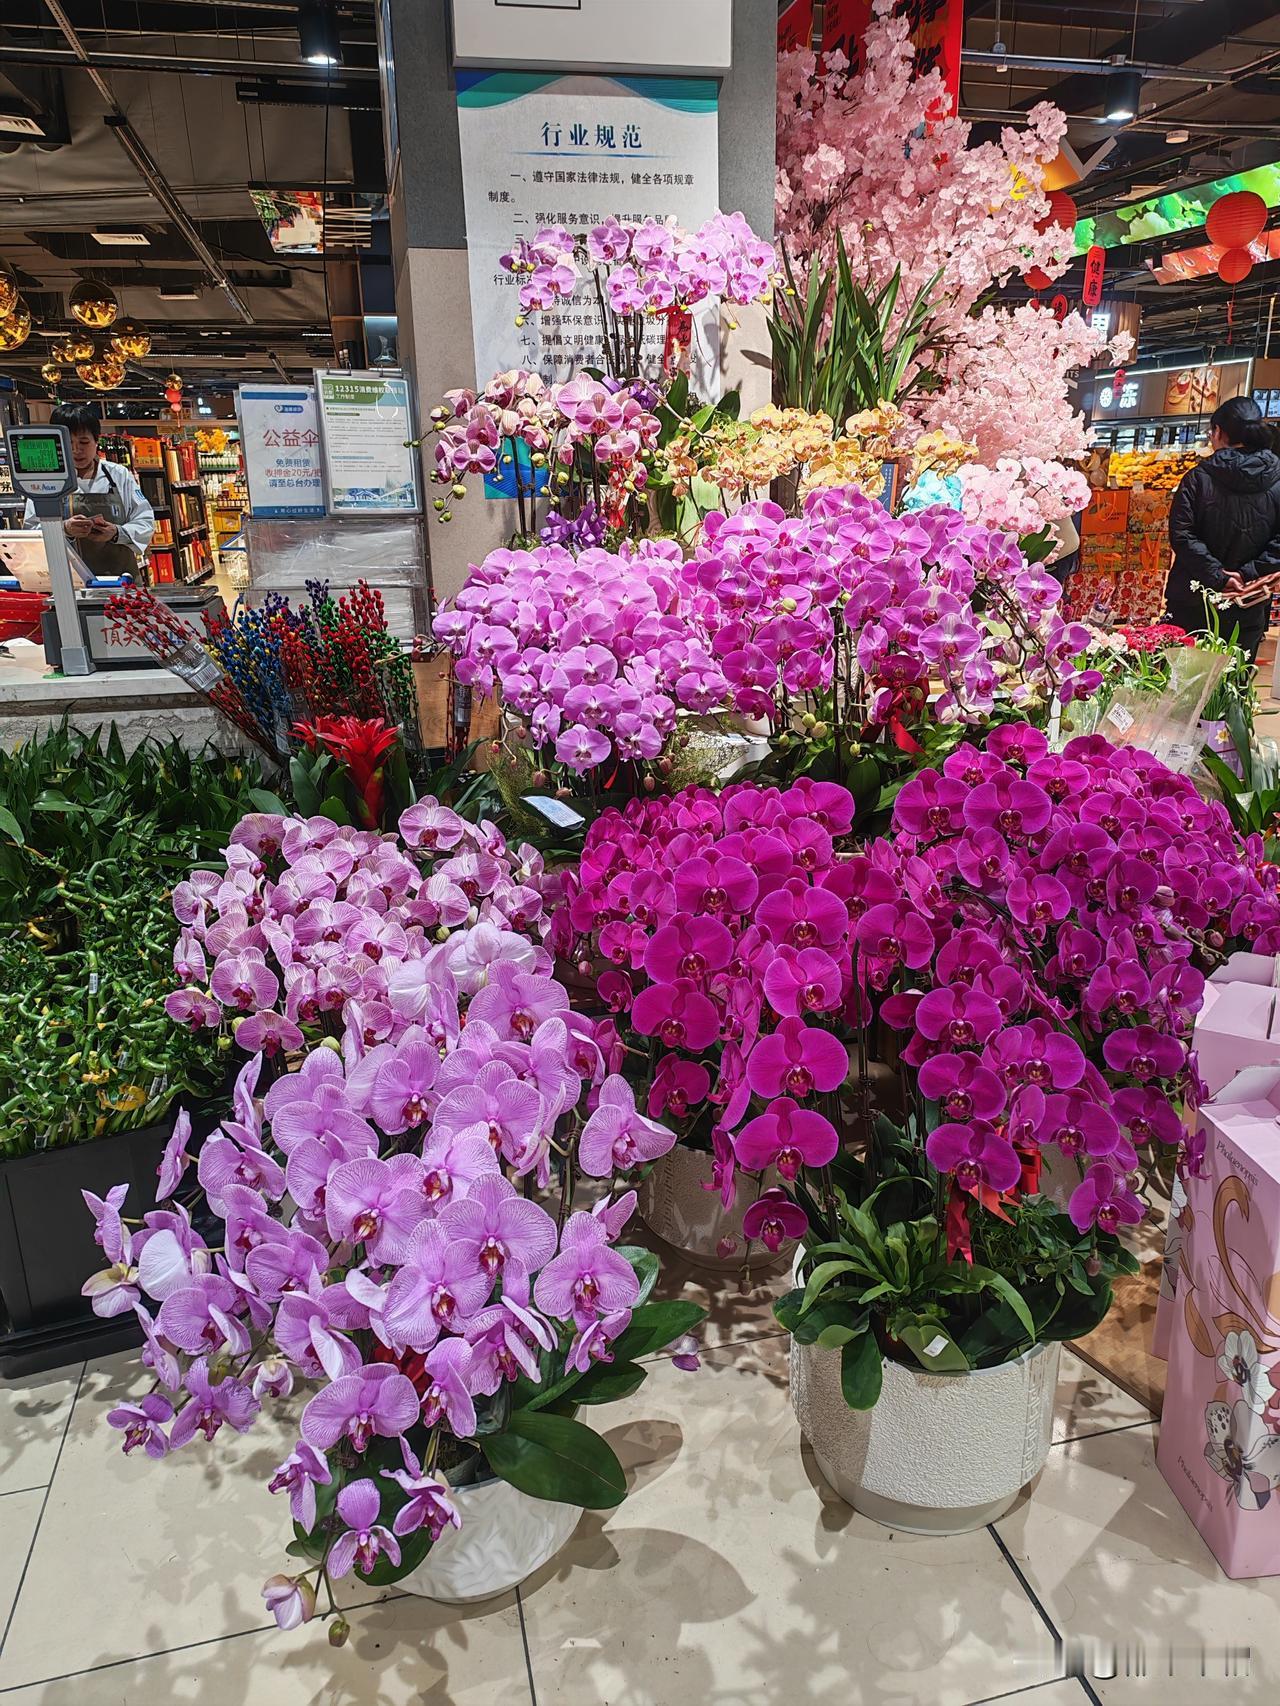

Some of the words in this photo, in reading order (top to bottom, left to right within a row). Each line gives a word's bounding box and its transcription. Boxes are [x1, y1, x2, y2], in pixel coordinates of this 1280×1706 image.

[541, 121, 643, 149] 行业规范
[510, 170, 694, 186] 一、遵守国家法律法规，健全各项规章
[487, 191, 516, 203] 制度。
[263, 429, 320, 447] 公益伞
[275, 458, 311, 468] 免费租赁
[269, 478, 320, 488] 请至总台办理
[1216, 1140, 1259, 1188] Phalaenopsis
